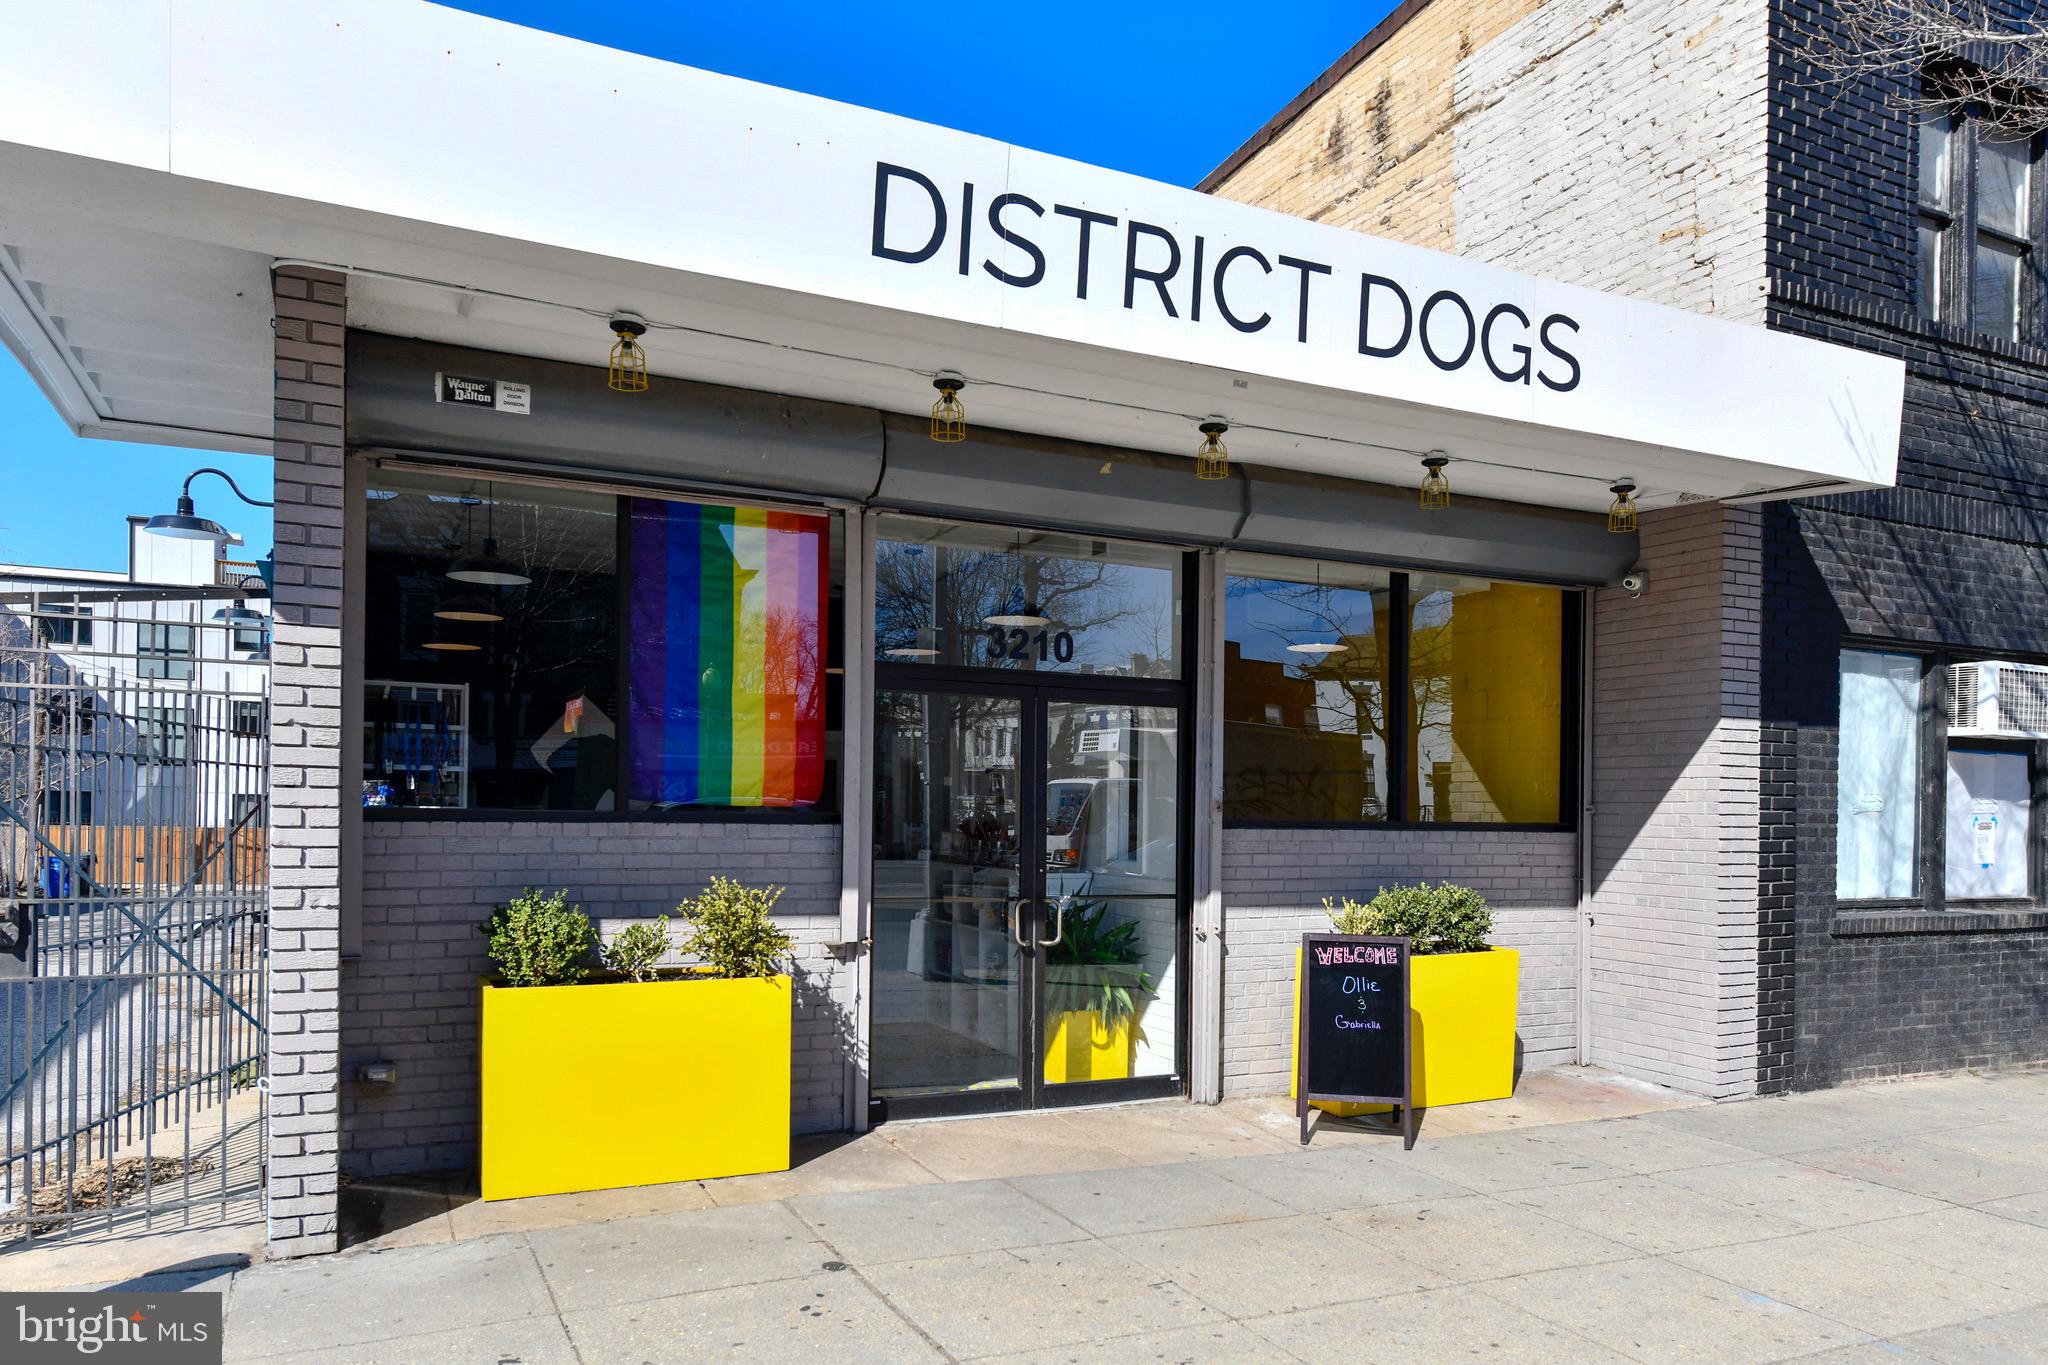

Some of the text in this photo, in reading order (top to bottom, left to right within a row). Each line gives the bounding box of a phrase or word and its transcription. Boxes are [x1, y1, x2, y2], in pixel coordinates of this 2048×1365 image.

[871, 161, 1581, 392] DISTRICT DOGS
[446, 377, 487, 393] Wayne
[503, 385, 526, 394] ROLLING
[454, 389, 492, 403] Dalton
[503, 400, 525, 408] DIVISION
[987, 626, 1074, 663] 3210
[1315, 946, 1398, 966] WELCOME
